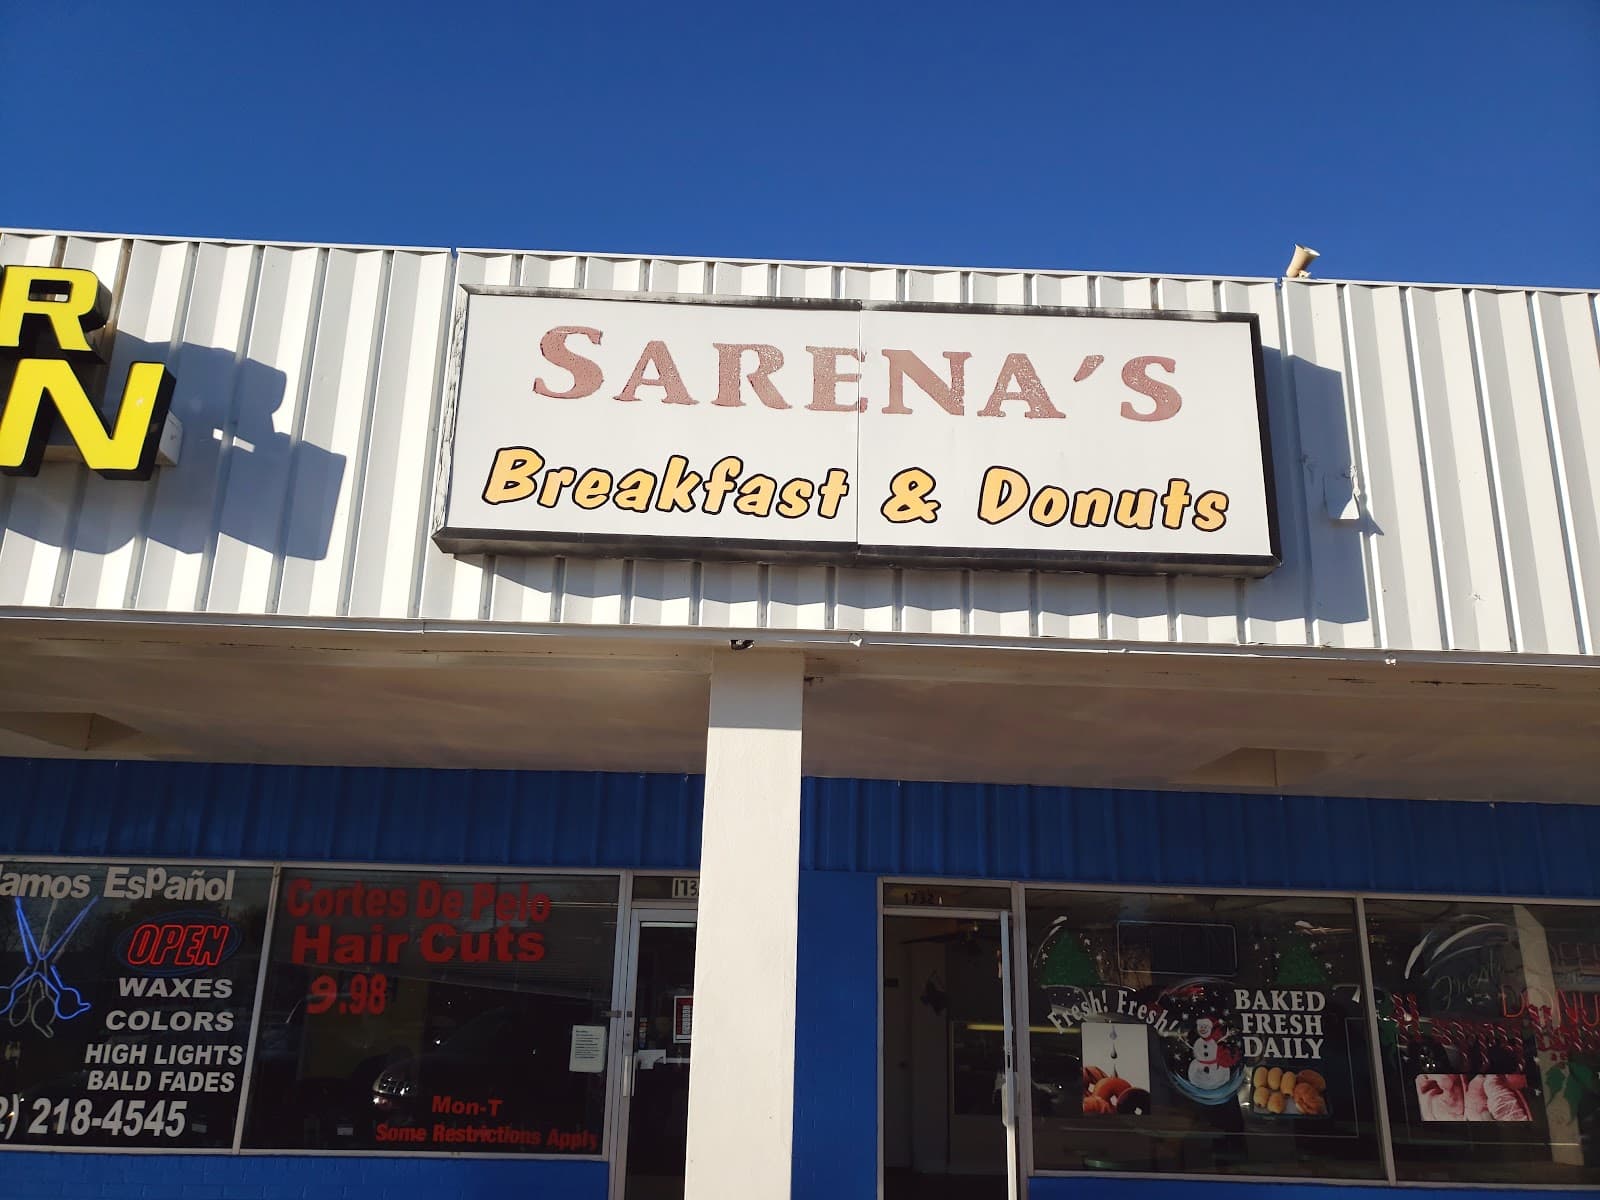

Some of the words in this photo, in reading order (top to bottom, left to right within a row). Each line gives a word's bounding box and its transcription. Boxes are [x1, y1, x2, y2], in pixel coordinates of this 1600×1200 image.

[533, 325, 1182, 422] SARENA'S
[482, 446, 850, 520] Breakfast
[880, 466, 942, 524] &
[977, 466, 1230, 532] Donuts
[0, 864, 91, 899] amos
[674, 880, 700, 897] 173
[287, 878, 408, 918] Cortes
[415, 879, 464, 919] De
[470, 882, 551, 922] Pelo
[127, 924, 230, 967] OPEN
[291, 924, 409, 965] Hair
[419, 922, 546, 963] Cuts
[118, 977, 233, 999] WAXES
[306, 973, 388, 1015] 9.98
[1233, 988, 1326, 1012] BAKED
[105, 1010, 235, 1032] COLORS
[1047, 989, 1110, 1035] Fresh!
[1240, 1012, 1324, 1036] FRESH
[84, 1043, 148, 1065] HIGH
[154, 1044, 243, 1066] LIGHTS
[1242, 1036, 1325, 1060] DAILY
[87, 1070, 152, 1092] BALD
[158, 1071, 236, 1093] FADES
[27, 1097, 188, 1137] 218-4545
[431, 1096, 504, 1117] Mon-T
[375, 1123, 428, 1143] Some
[432, 1124, 542, 1146] Restrictions
[546, 1128, 600, 1150] Apply
